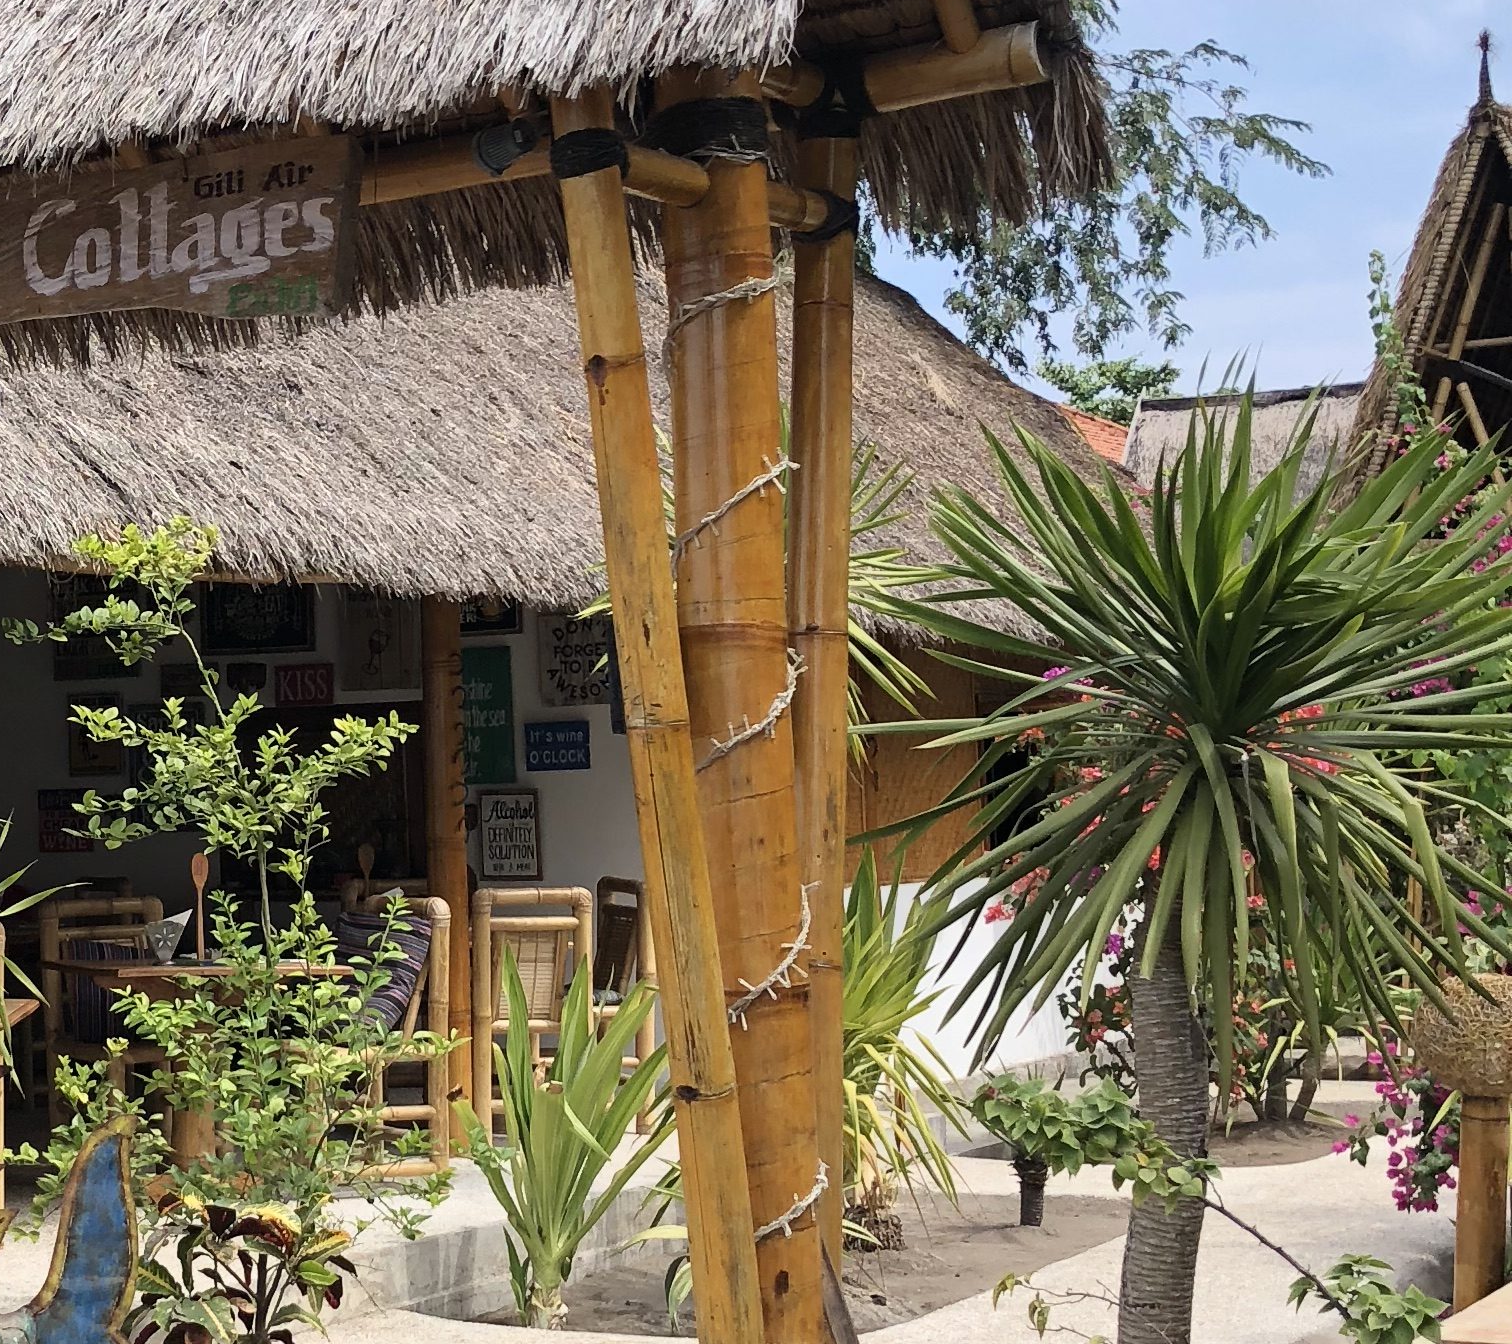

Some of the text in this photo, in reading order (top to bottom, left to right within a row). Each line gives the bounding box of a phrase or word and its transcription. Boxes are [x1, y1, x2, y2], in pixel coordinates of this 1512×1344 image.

[193, 161, 314, 199] Gili Air
[23, 181, 336, 297] Cottages
[560, 660, 581, 674] TO
[278, 669, 330, 701] KISS
[530, 729, 585, 743] It's wine
[529, 748, 587, 764] O'CLOCK
[483, 800, 536, 822] Alcohol
[488, 844, 535, 860] SOLUTION
